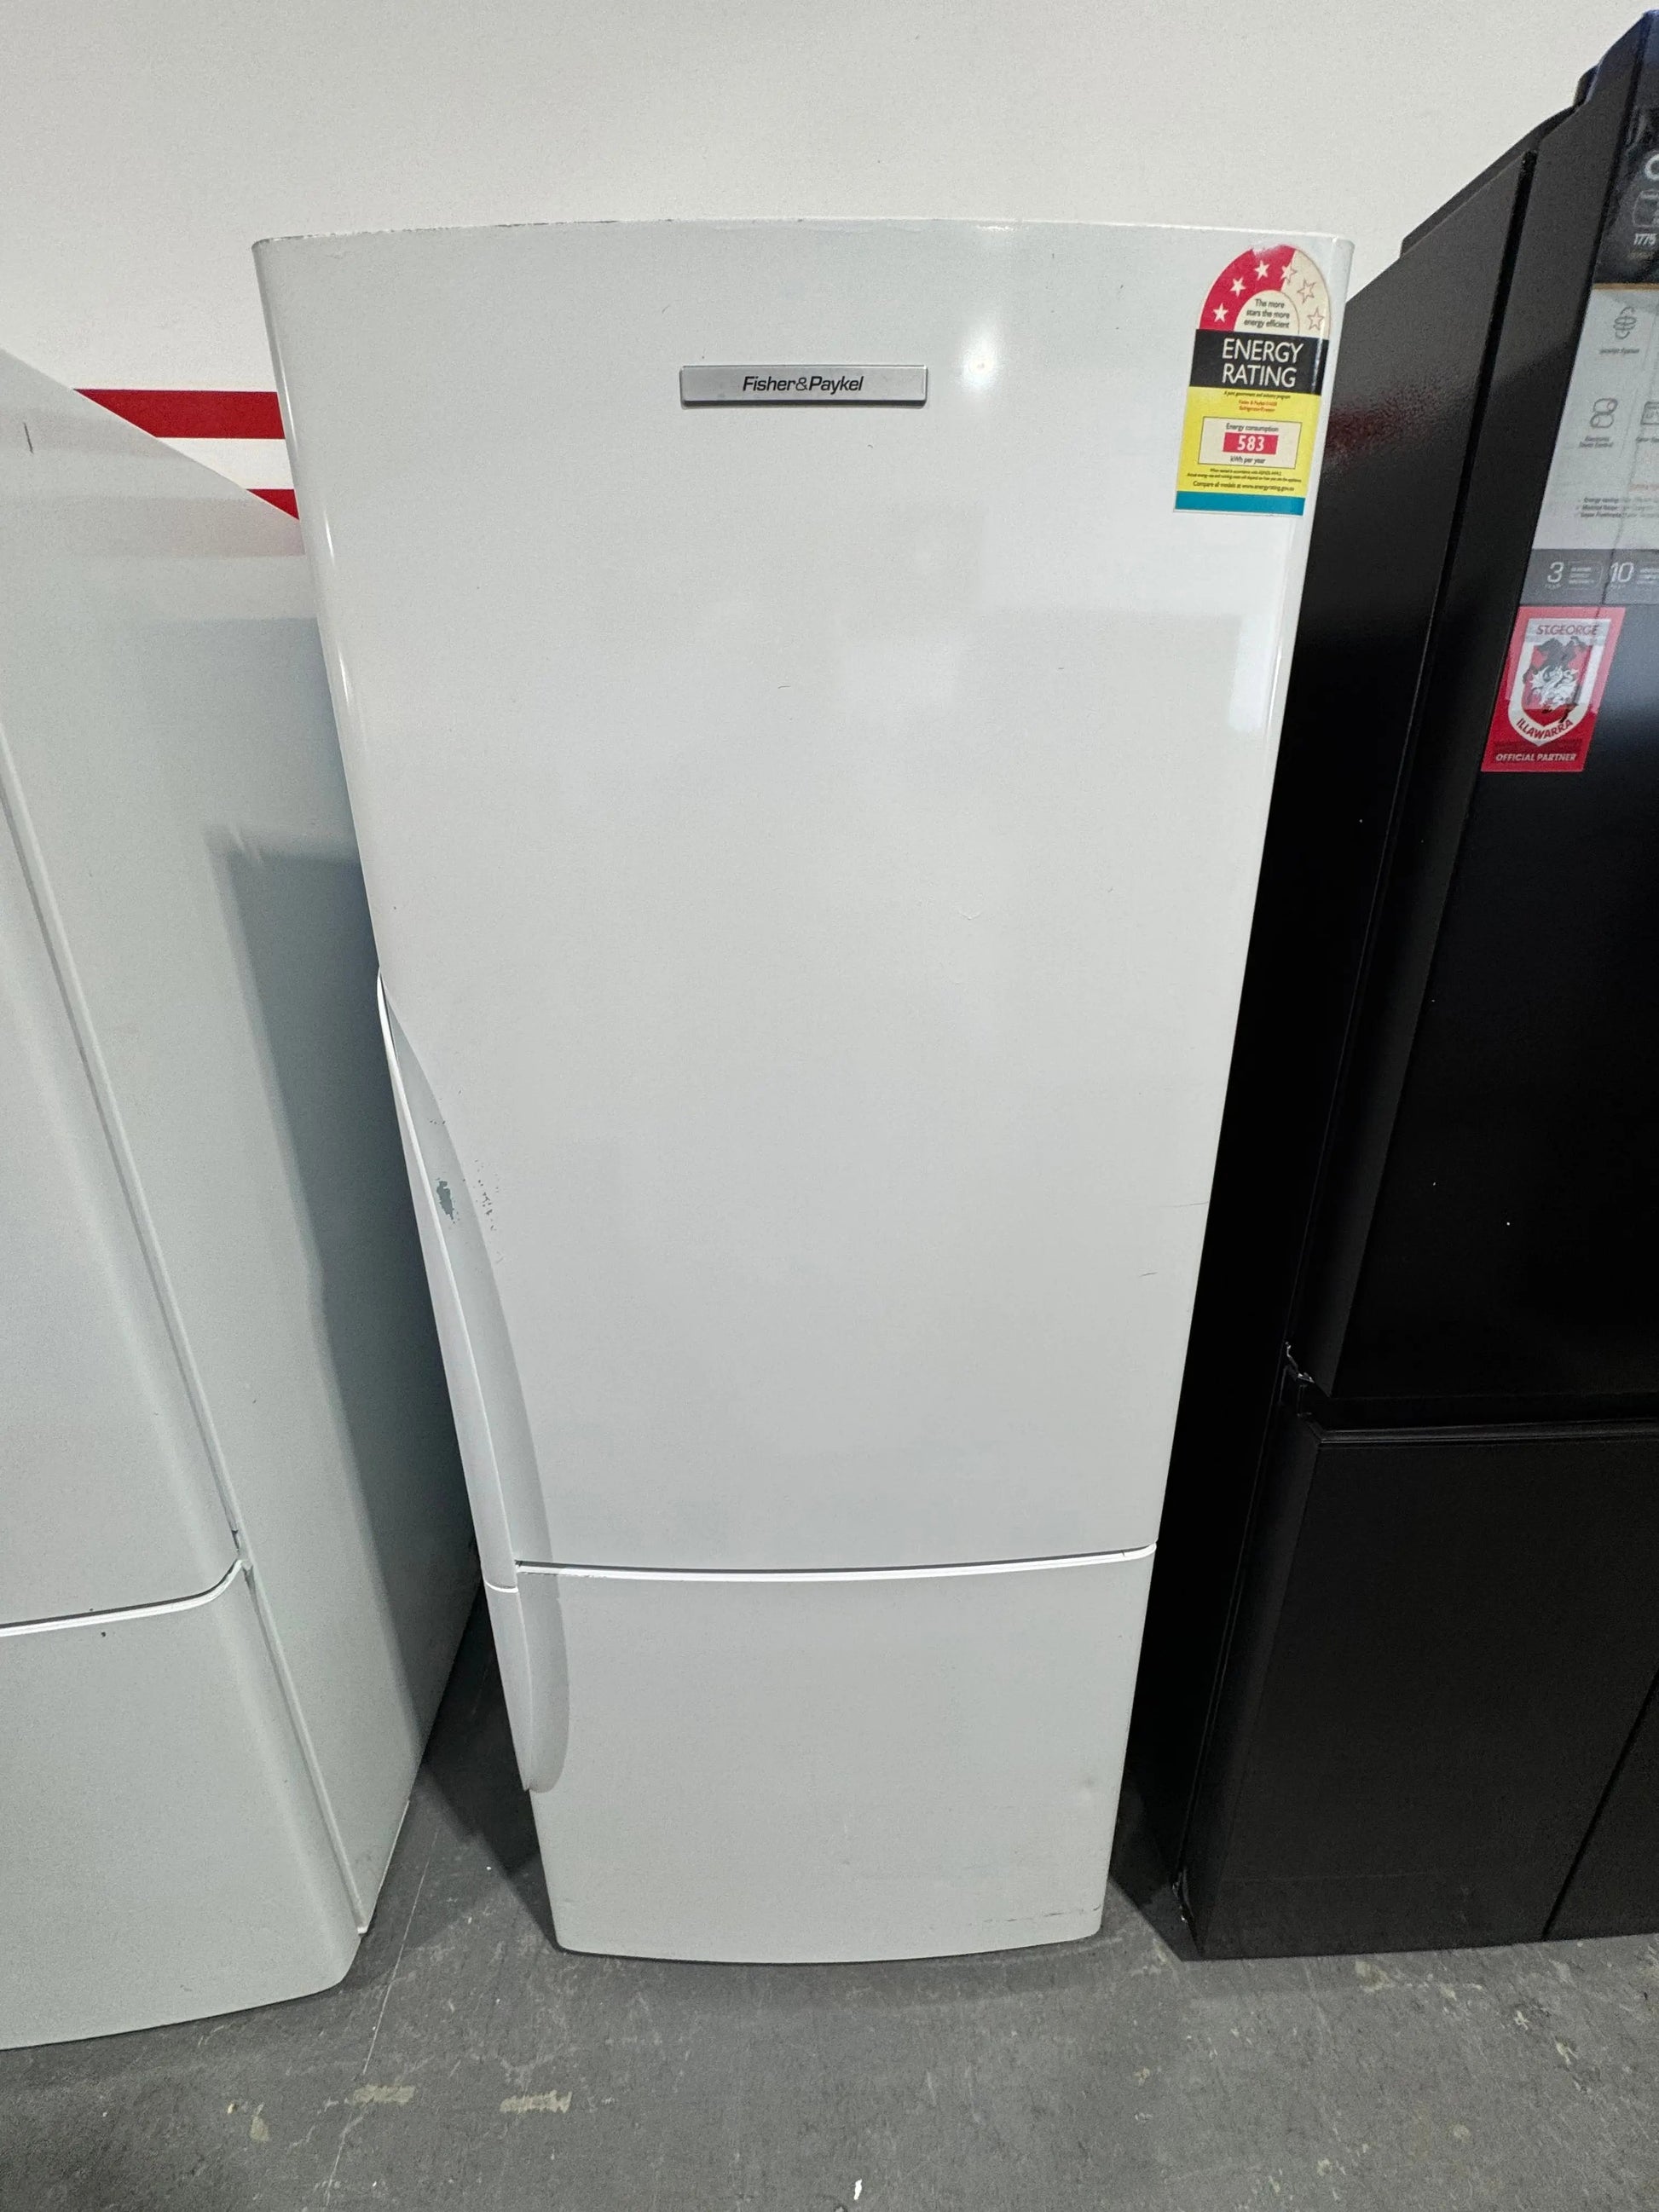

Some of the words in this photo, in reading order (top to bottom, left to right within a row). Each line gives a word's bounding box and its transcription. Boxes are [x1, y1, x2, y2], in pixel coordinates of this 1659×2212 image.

[1255, 298, 1267, 307] The
[1262, 309, 1273, 318] the
[1244, 319, 1264, 328] energy
[1265, 319, 1290, 328] efficient
[1222, 338, 1304, 364] ENERGY
[1222, 363, 1297, 388] RATING
[743, 376, 864, 395] Fisher&Paykel
[1226, 423, 1245, 431] Energy
[1237, 435, 1265, 452] 583
[1193, 480, 1214, 488] Compare
[1547, 562, 1564, 583] 3
[1610, 562, 1635, 583] 10
[1516, 718, 1573, 740] ILLAWARRA
[1495, 753, 1535, 761] OFFICIAL
[1536, 753, 1577, 761] PARTNER
